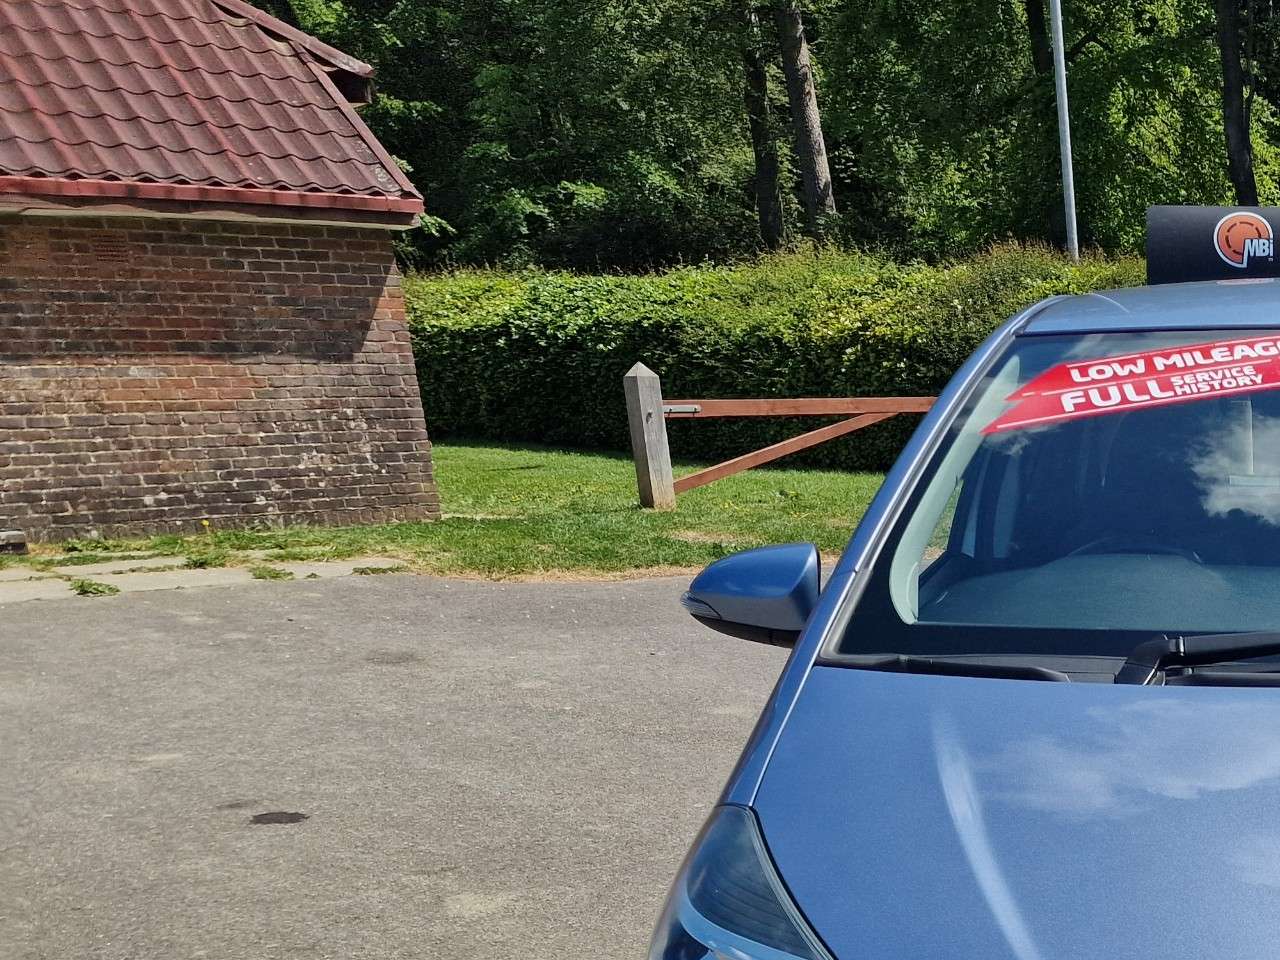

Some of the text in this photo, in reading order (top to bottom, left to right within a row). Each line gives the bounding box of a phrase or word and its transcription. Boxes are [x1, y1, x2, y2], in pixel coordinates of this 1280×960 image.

[1068, 358, 1145, 383] LOW
[1060, 366, 1257, 413] FULL SERVICE
[1175, 374, 1265, 397] HISTORY
